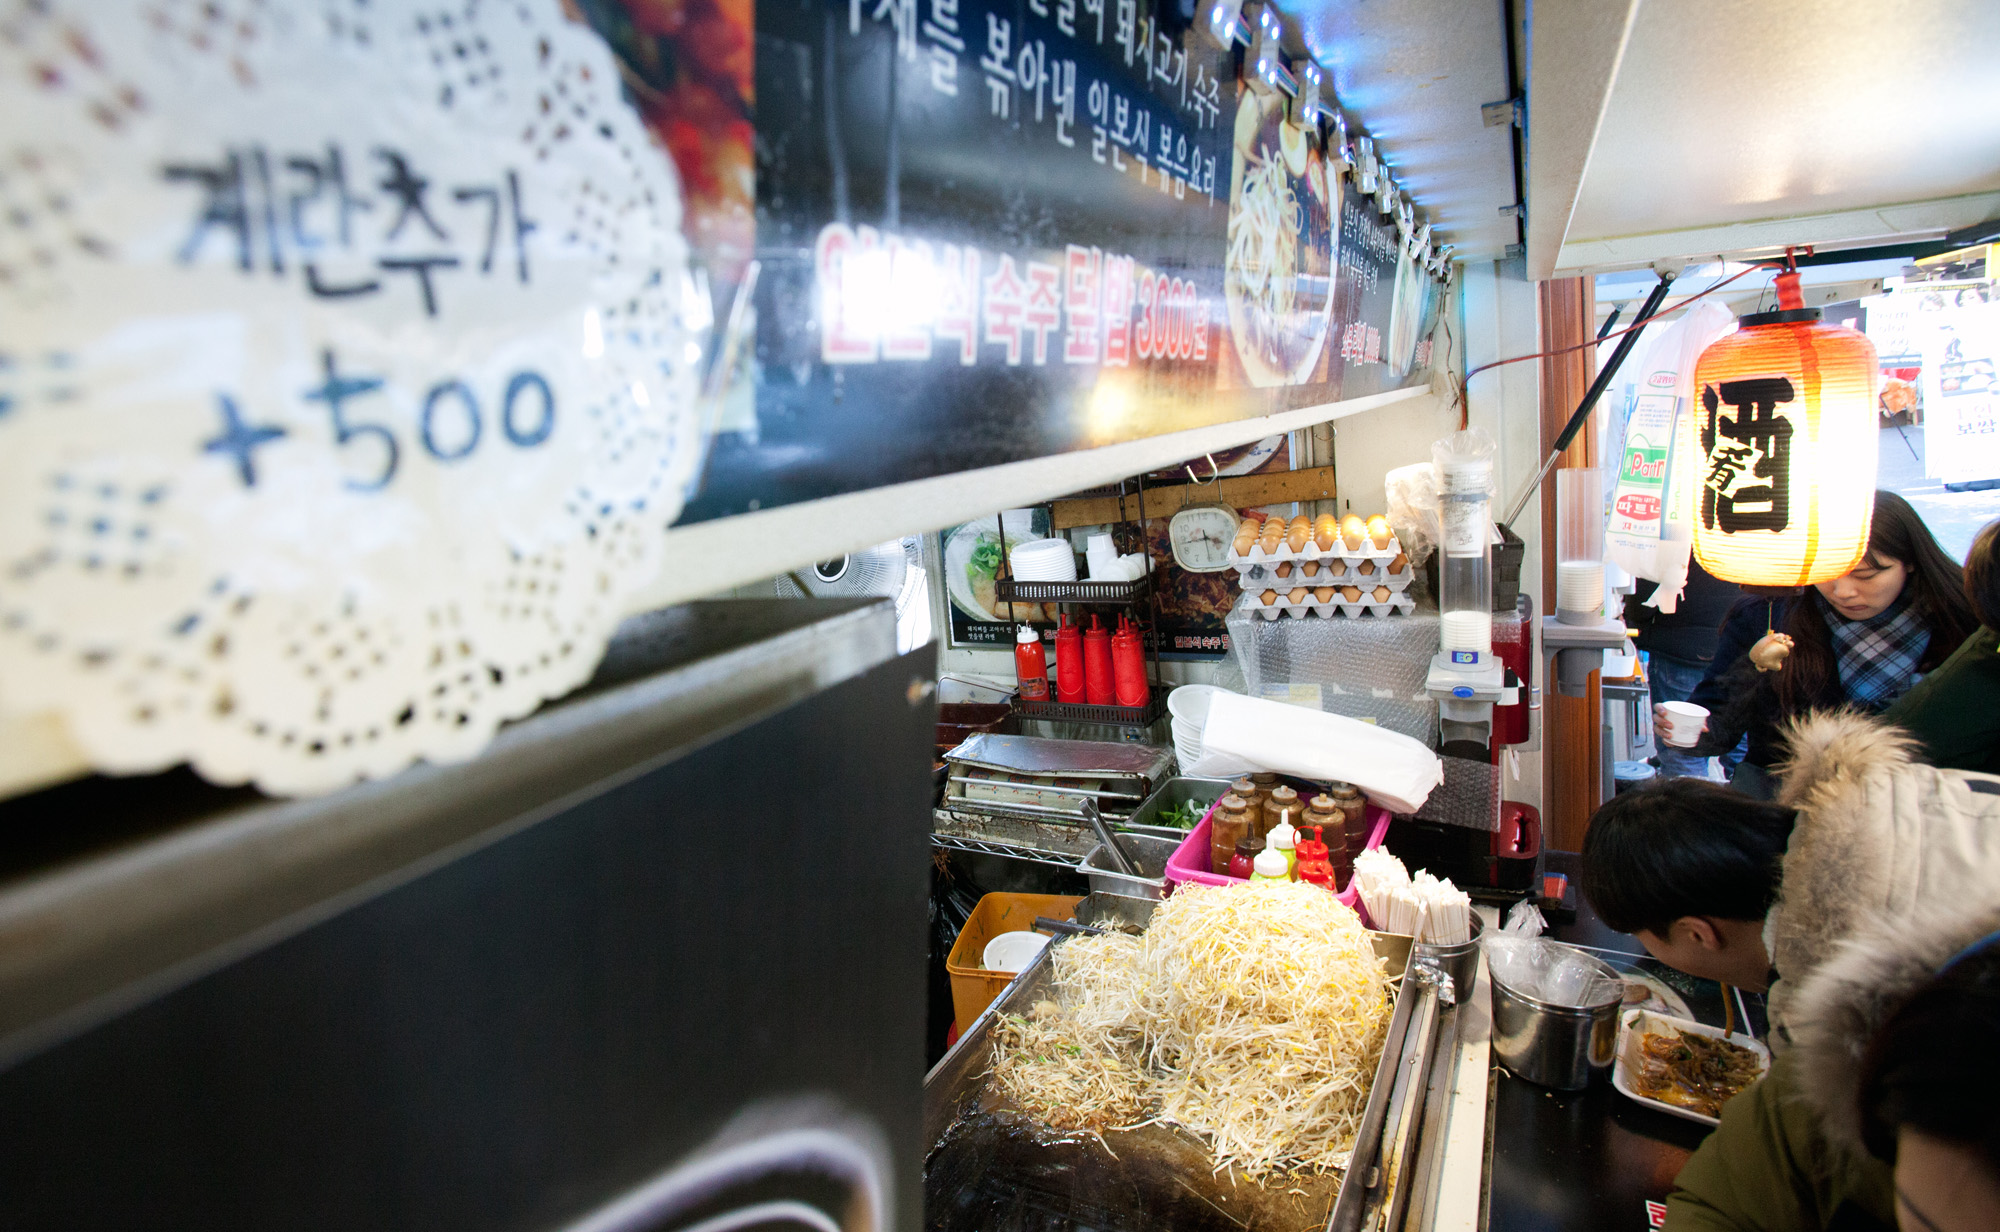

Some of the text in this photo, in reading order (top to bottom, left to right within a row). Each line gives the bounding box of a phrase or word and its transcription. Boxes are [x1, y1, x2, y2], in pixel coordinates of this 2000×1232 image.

[980, 12, 1076, 147] 볶아낸
[1087, 79, 1150, 183] 일본식
[1157, 123, 1216, 207] 볶음요리
[160, 142, 537, 316] 계란추가
[1175, 635, 1202, 649] 일본식
[1202, 636, 1221, 649] 숙주
